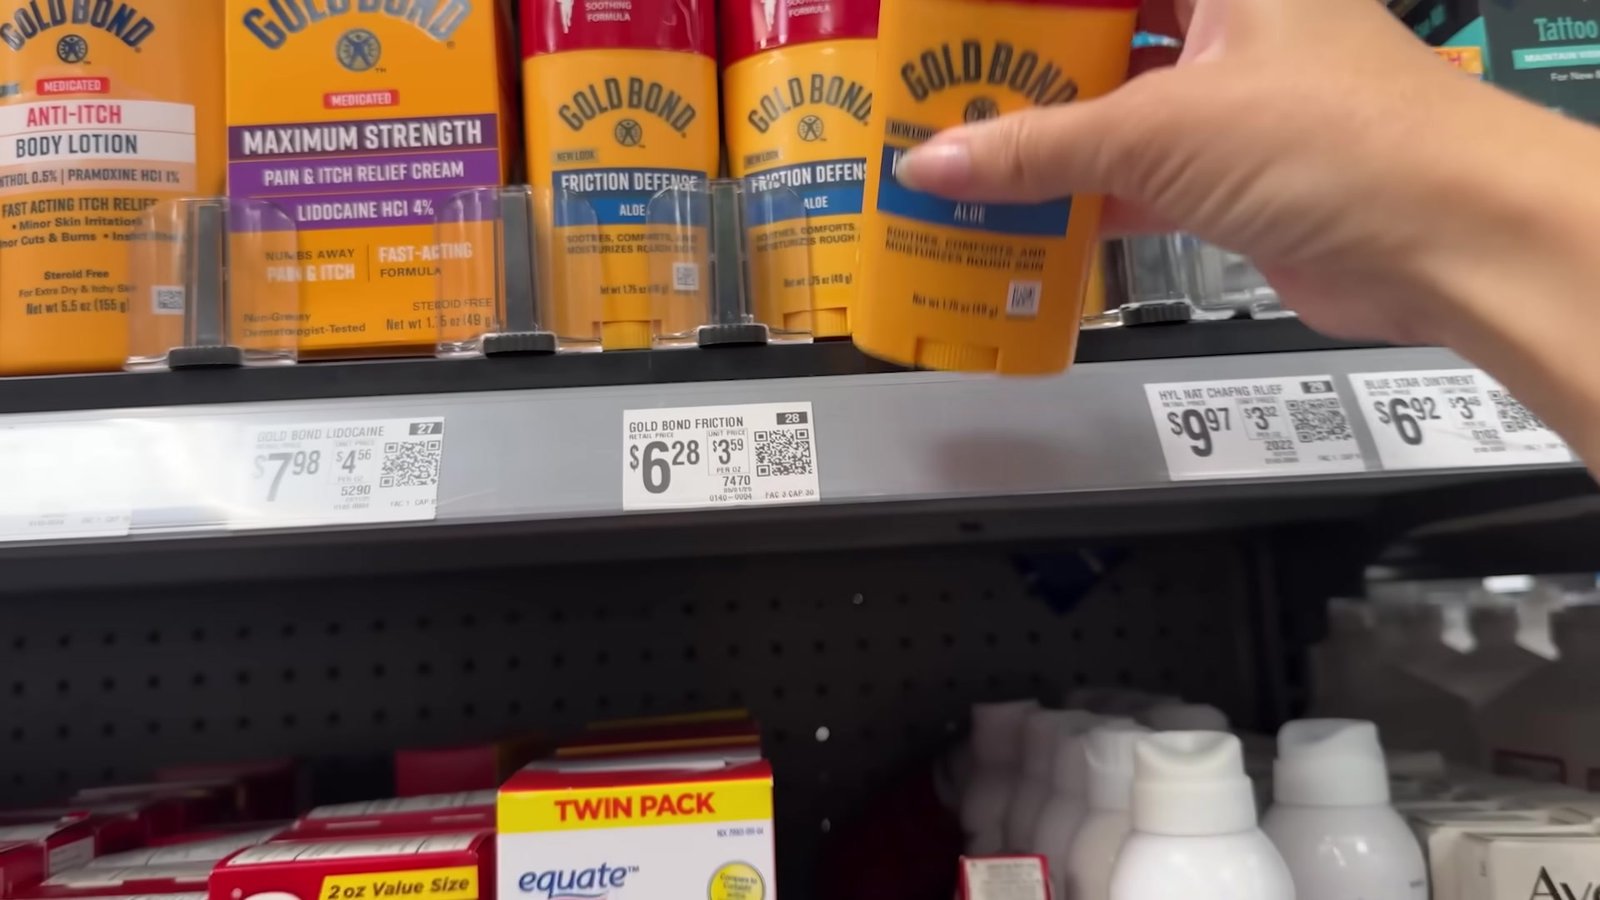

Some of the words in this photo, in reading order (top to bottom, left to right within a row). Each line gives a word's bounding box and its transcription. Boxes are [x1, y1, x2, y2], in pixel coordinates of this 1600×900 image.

[585, 1, 632, 11] SOOTHING
[0, 0, 67, 51] GOLD
[72, 0, 155, 48] BOND
[586, 13, 631, 22] FORMULA
[1533, 16, 1598, 41] Tattoo
[900, 39, 982, 102] GOLD
[43, 80, 102, 92] MEDICATED
[331, 92, 392, 106] MEDICATED
[558, 78, 623, 131] GOLD
[627, 77, 696, 132] BOND
[748, 77, 805, 133] GOLD
[810, 74, 873, 122] BOND
[27, 104, 122, 127] ANTI-ITCH
[16, 135, 62, 158] BODY
[68, 134, 138, 154] LOTION
[243, 126, 358, 155] MAXIMUM
[365, 120, 482, 149] STRENGTH
[32, 170, 57, 184] 0.5%
[68, 168, 137, 182] PRAMOXINE
[264, 169, 299, 186] PAIN
[304, 168, 315, 184] &
[319, 165, 352, 183] ITCH
[358, 164, 407, 182] RELIEF
[412, 161, 464, 180] CREAM
[561, 173, 629, 192] FRICTION
[2, 202, 27, 217] FAST
[31, 198, 74, 213] ACTING
[80, 198, 109, 211] ITCH
[298, 202, 379, 222] LIDOCAINE
[413, 199, 434, 216] 4%
[619, 204, 646, 217] ALOE
[803, 196, 828, 209] ALOE
[954, 203, 985, 224] ALOE
[19, 219, 51, 231] Minor
[55, 217, 81, 227] Skin
[21, 235, 45, 246] Cuts
[48, 233, 57, 243] &
[61, 232, 96, 243] Burns
[820, 234, 855, 244] ROUGH
[317, 249, 355, 260] AWAY
[378, 243, 473, 263] FAST-ACTING
[44, 270, 82, 280] Steroid
[86, 269, 109, 278] Free
[306, 266, 317, 281] &
[322, 264, 355, 280] ITCH
[380, 267, 442, 279] FORMULA
[19, 289, 33, 298] For
[35, 286, 58, 297] Extra
[62, 284, 77, 295] Dry
[26, 303, 42, 315] Net
[46, 303, 58, 313] wt
[61, 301, 78, 312] 5.5
[80, 302, 91, 312] oz
[94, 299, 118, 312] (155
[386, 319, 404, 331] Net
[408, 319, 421, 329] wt
[1364, 379, 1391, 390] BLUE
[1394, 378, 1420, 388] STAR
[1423, 375, 1476, 386] OINTMENT
[1159, 390, 1182, 400] HYL
[1184, 389, 1204, 399] NAT
[1206, 386, 1250, 398] CHAFNG
[257, 430, 288, 442] GOLD
[291, 428, 322, 441] BOND
[326, 425, 385, 439] LIDOCAINE
[417, 423, 434, 434] 27
[629, 421, 658, 433] GOLD
[662, 419, 691, 430] BOND
[695, 416, 744, 429] FRICTION
[785, 413, 800, 424] 28
[1167, 407, 1231, 457] $997
[1265, 440, 1294, 450] 2022
[253, 450, 321, 502] $798
[336, 448, 372, 474] $456
[630, 440, 700, 494] $628
[712, 438, 744, 465] $359
[341, 485, 371, 496] 5290
[722, 475, 751, 487] 7470
[555, 797, 632, 822] TWIN
[640, 792, 715, 817] PACK
[328, 885, 341, 900] 2
[344, 887, 365, 898] oz
[372, 882, 424, 896] Value
[430, 877, 469, 893] Size
[1529, 866, 1600, 900] Av
